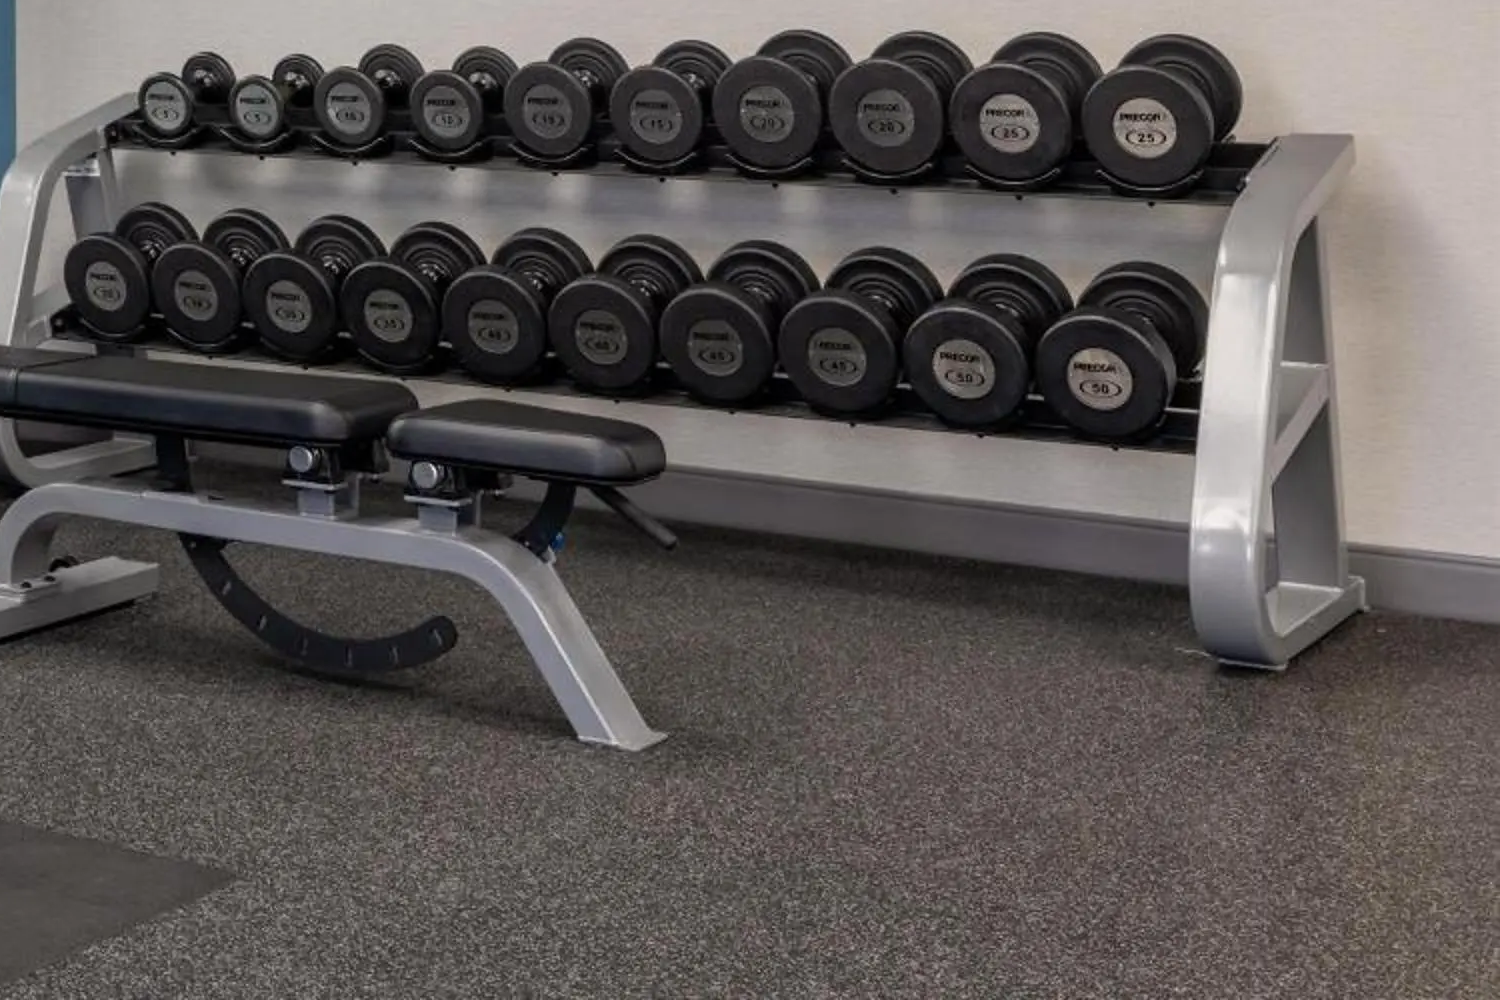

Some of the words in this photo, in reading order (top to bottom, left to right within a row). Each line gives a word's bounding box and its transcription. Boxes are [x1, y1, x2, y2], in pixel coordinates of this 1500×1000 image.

[985, 108, 1025, 118] PRECOR
[1119, 112, 1161, 123] PRECOR
[1003, 127, 1019, 139] 25
[1137, 133, 1155, 144] 25
[939, 352, 980, 363] PRECOR
[956, 373, 973, 383] 50
[1091, 383, 1109, 394] 50
